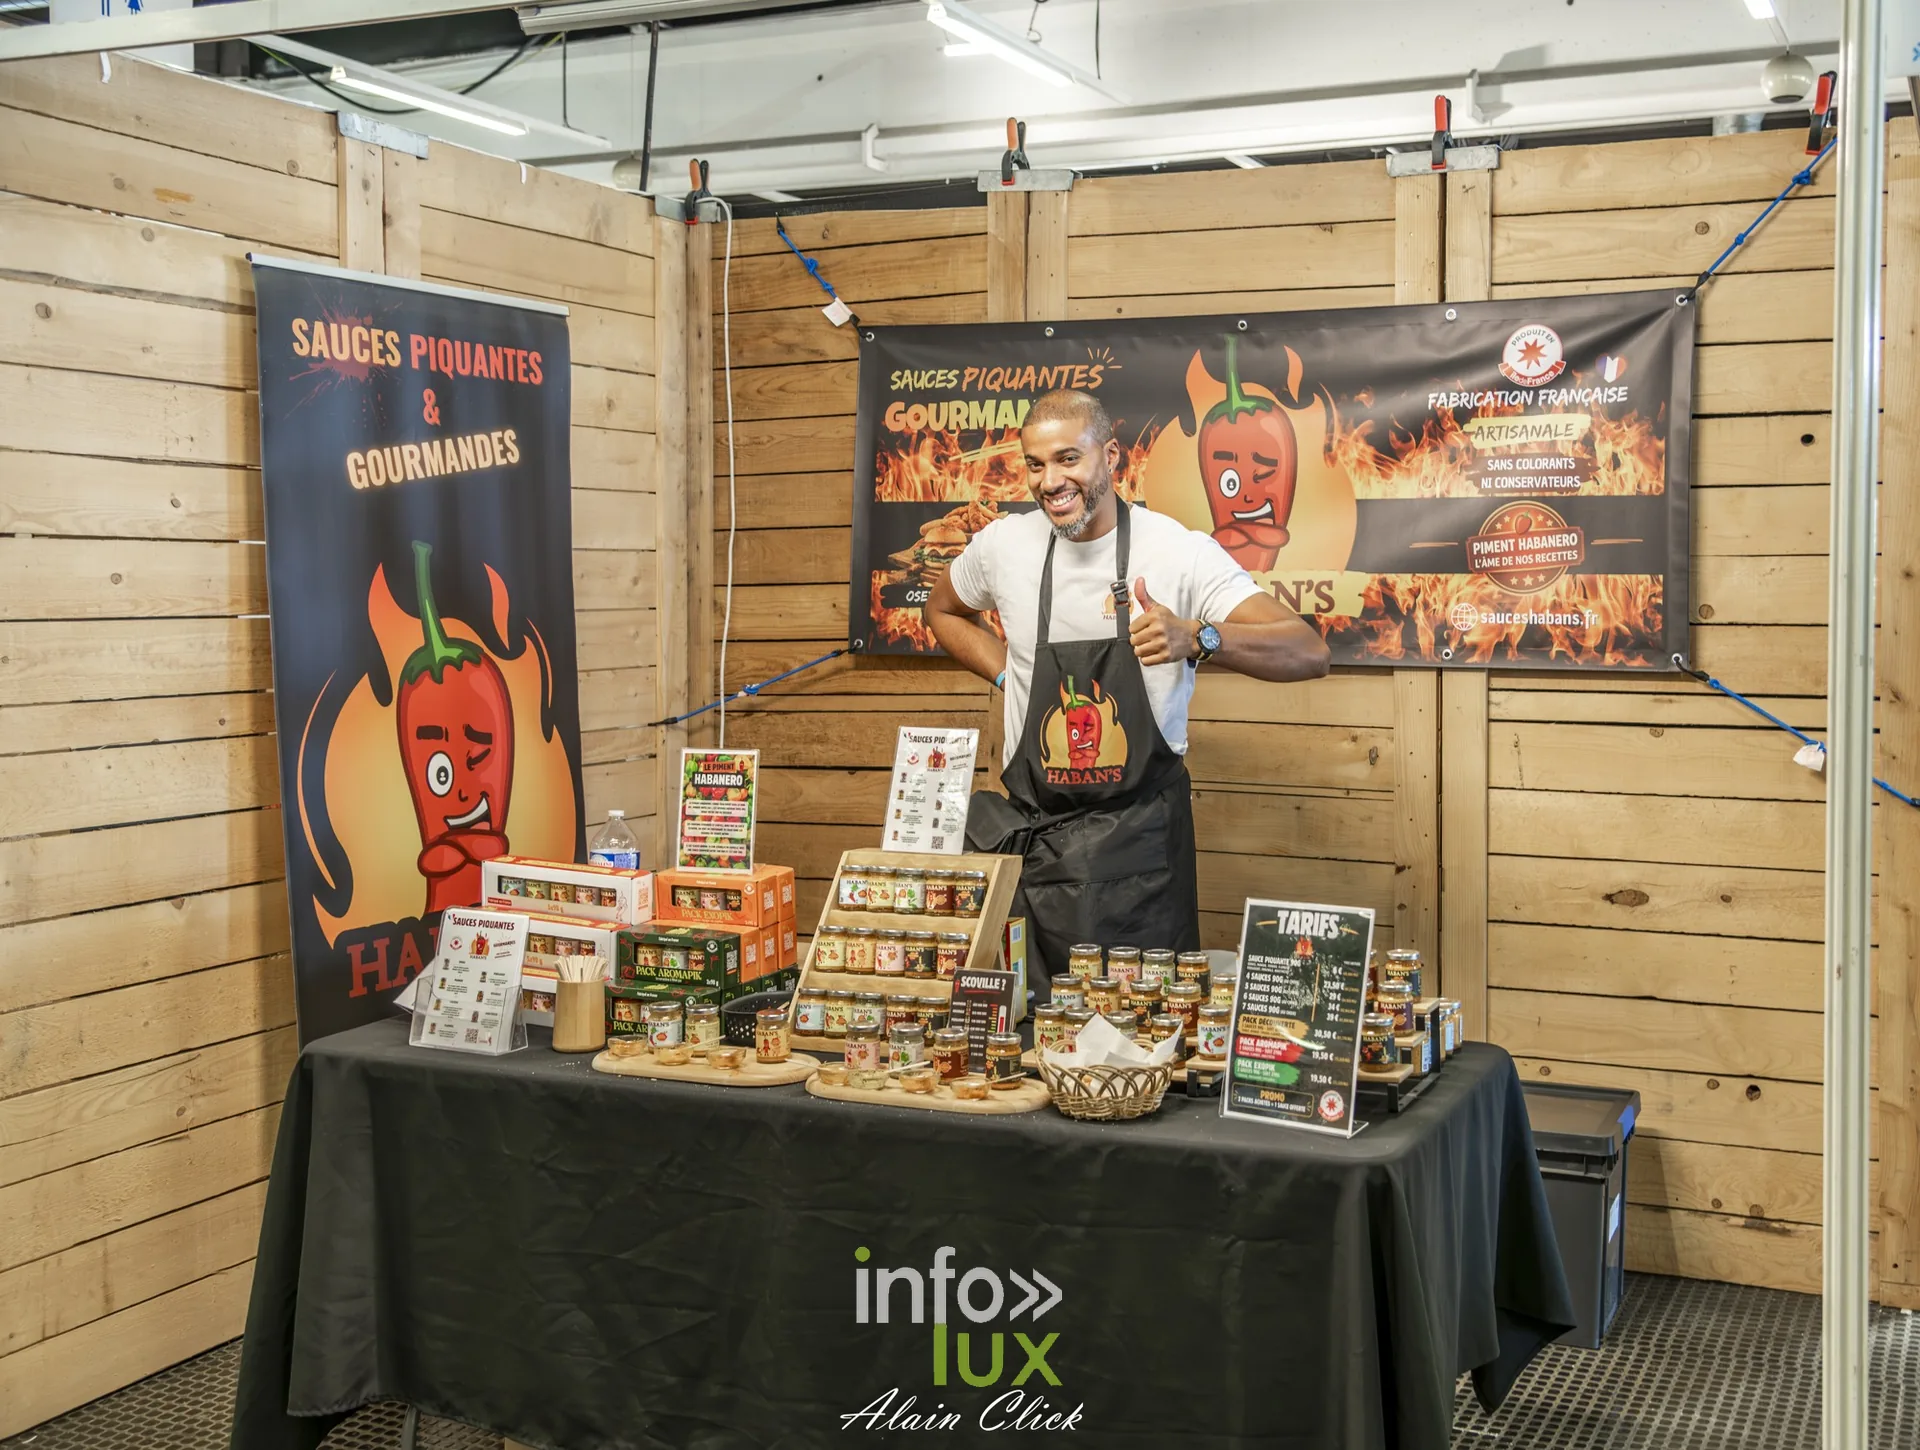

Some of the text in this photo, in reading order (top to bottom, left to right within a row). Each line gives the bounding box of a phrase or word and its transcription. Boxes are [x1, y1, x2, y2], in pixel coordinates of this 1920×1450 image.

[1512, 329, 1555, 346] PRODUIT EN
[292, 318, 543, 386] SAUCES PIQUANTES
[890, 364, 1104, 392] SAUCES PIQUANTES
[1428, 386, 1628, 409] FABRICATION FRANÇAISE
[423, 388, 441, 426] &
[885, 399, 1032, 432] GOURMAN
[1474, 423, 1574, 442] ARTISANALE
[346, 429, 520, 490] GOURMANDES
[1488, 458, 1575, 470] SANS COLORANTS
[1481, 476, 1580, 488] NI CONSERVATEURS
[1473, 533, 1577, 555] PIMENT HABANERO
[1502, 555, 1513, 566] DE
[1516, 554, 1533, 565] NOS
[1536, 550, 1577, 564] RECETTES
[906, 590, 930, 602] OSE
[1270, 580, 1335, 613] N'S
[1481, 609, 1598, 629] sauceshabans.fr
[909, 735, 932, 744] SAUCES
[704, 763, 734, 771] LE PIMENT
[694, 773, 743, 786] HABANERO
[1047, 768, 1122, 784] HABAN'S
[682, 909, 701, 918] PACK
[704, 910, 733, 921] EXOPIK
[453, 917, 515, 931] SAUCES PIQUANTES
[1278, 910, 1339, 939] TARIFS
[347, 928, 437, 998] HA
[1248, 954, 1263, 962] SAUCE
[1265, 955, 1289, 965] PIQUANTE
[636, 966, 656, 976] PACK
[659, 969, 702, 980] AROMAPIK
[1333, 966, 1337, 975] 6
[961, 976, 1006, 991] SCOVILLE ?
[1246, 972, 1284, 984] 4 SAUCES 90G
[1245, 982, 1283, 994] 5 SAUCES 90G
[1243, 992, 1281, 1004] 6 SAUCES 90G
[1242, 1002, 1247, 1010] 7
[1247, 1003, 1268, 1012] SAUCES
[1269, 1005, 1280, 1014] 90G
[1328, 1003, 1335, 1011] 34
[1243, 1016, 1295, 1029] PACK DÉCOUVERTE
[1327, 1013, 1334, 1021] 39
[614, 1021, 648, 1033] PACK AR
[1314, 1029, 1331, 1039] 30,50
[1240, 1037, 1287, 1051] PACK AROMAPIK
[1312, 1051, 1328, 1060] 19,50
[1238, 1059, 1252, 1069] PACK
[1311, 1074, 1327, 1084] 19,50
[1261, 1090, 1285, 1102] PROMO
